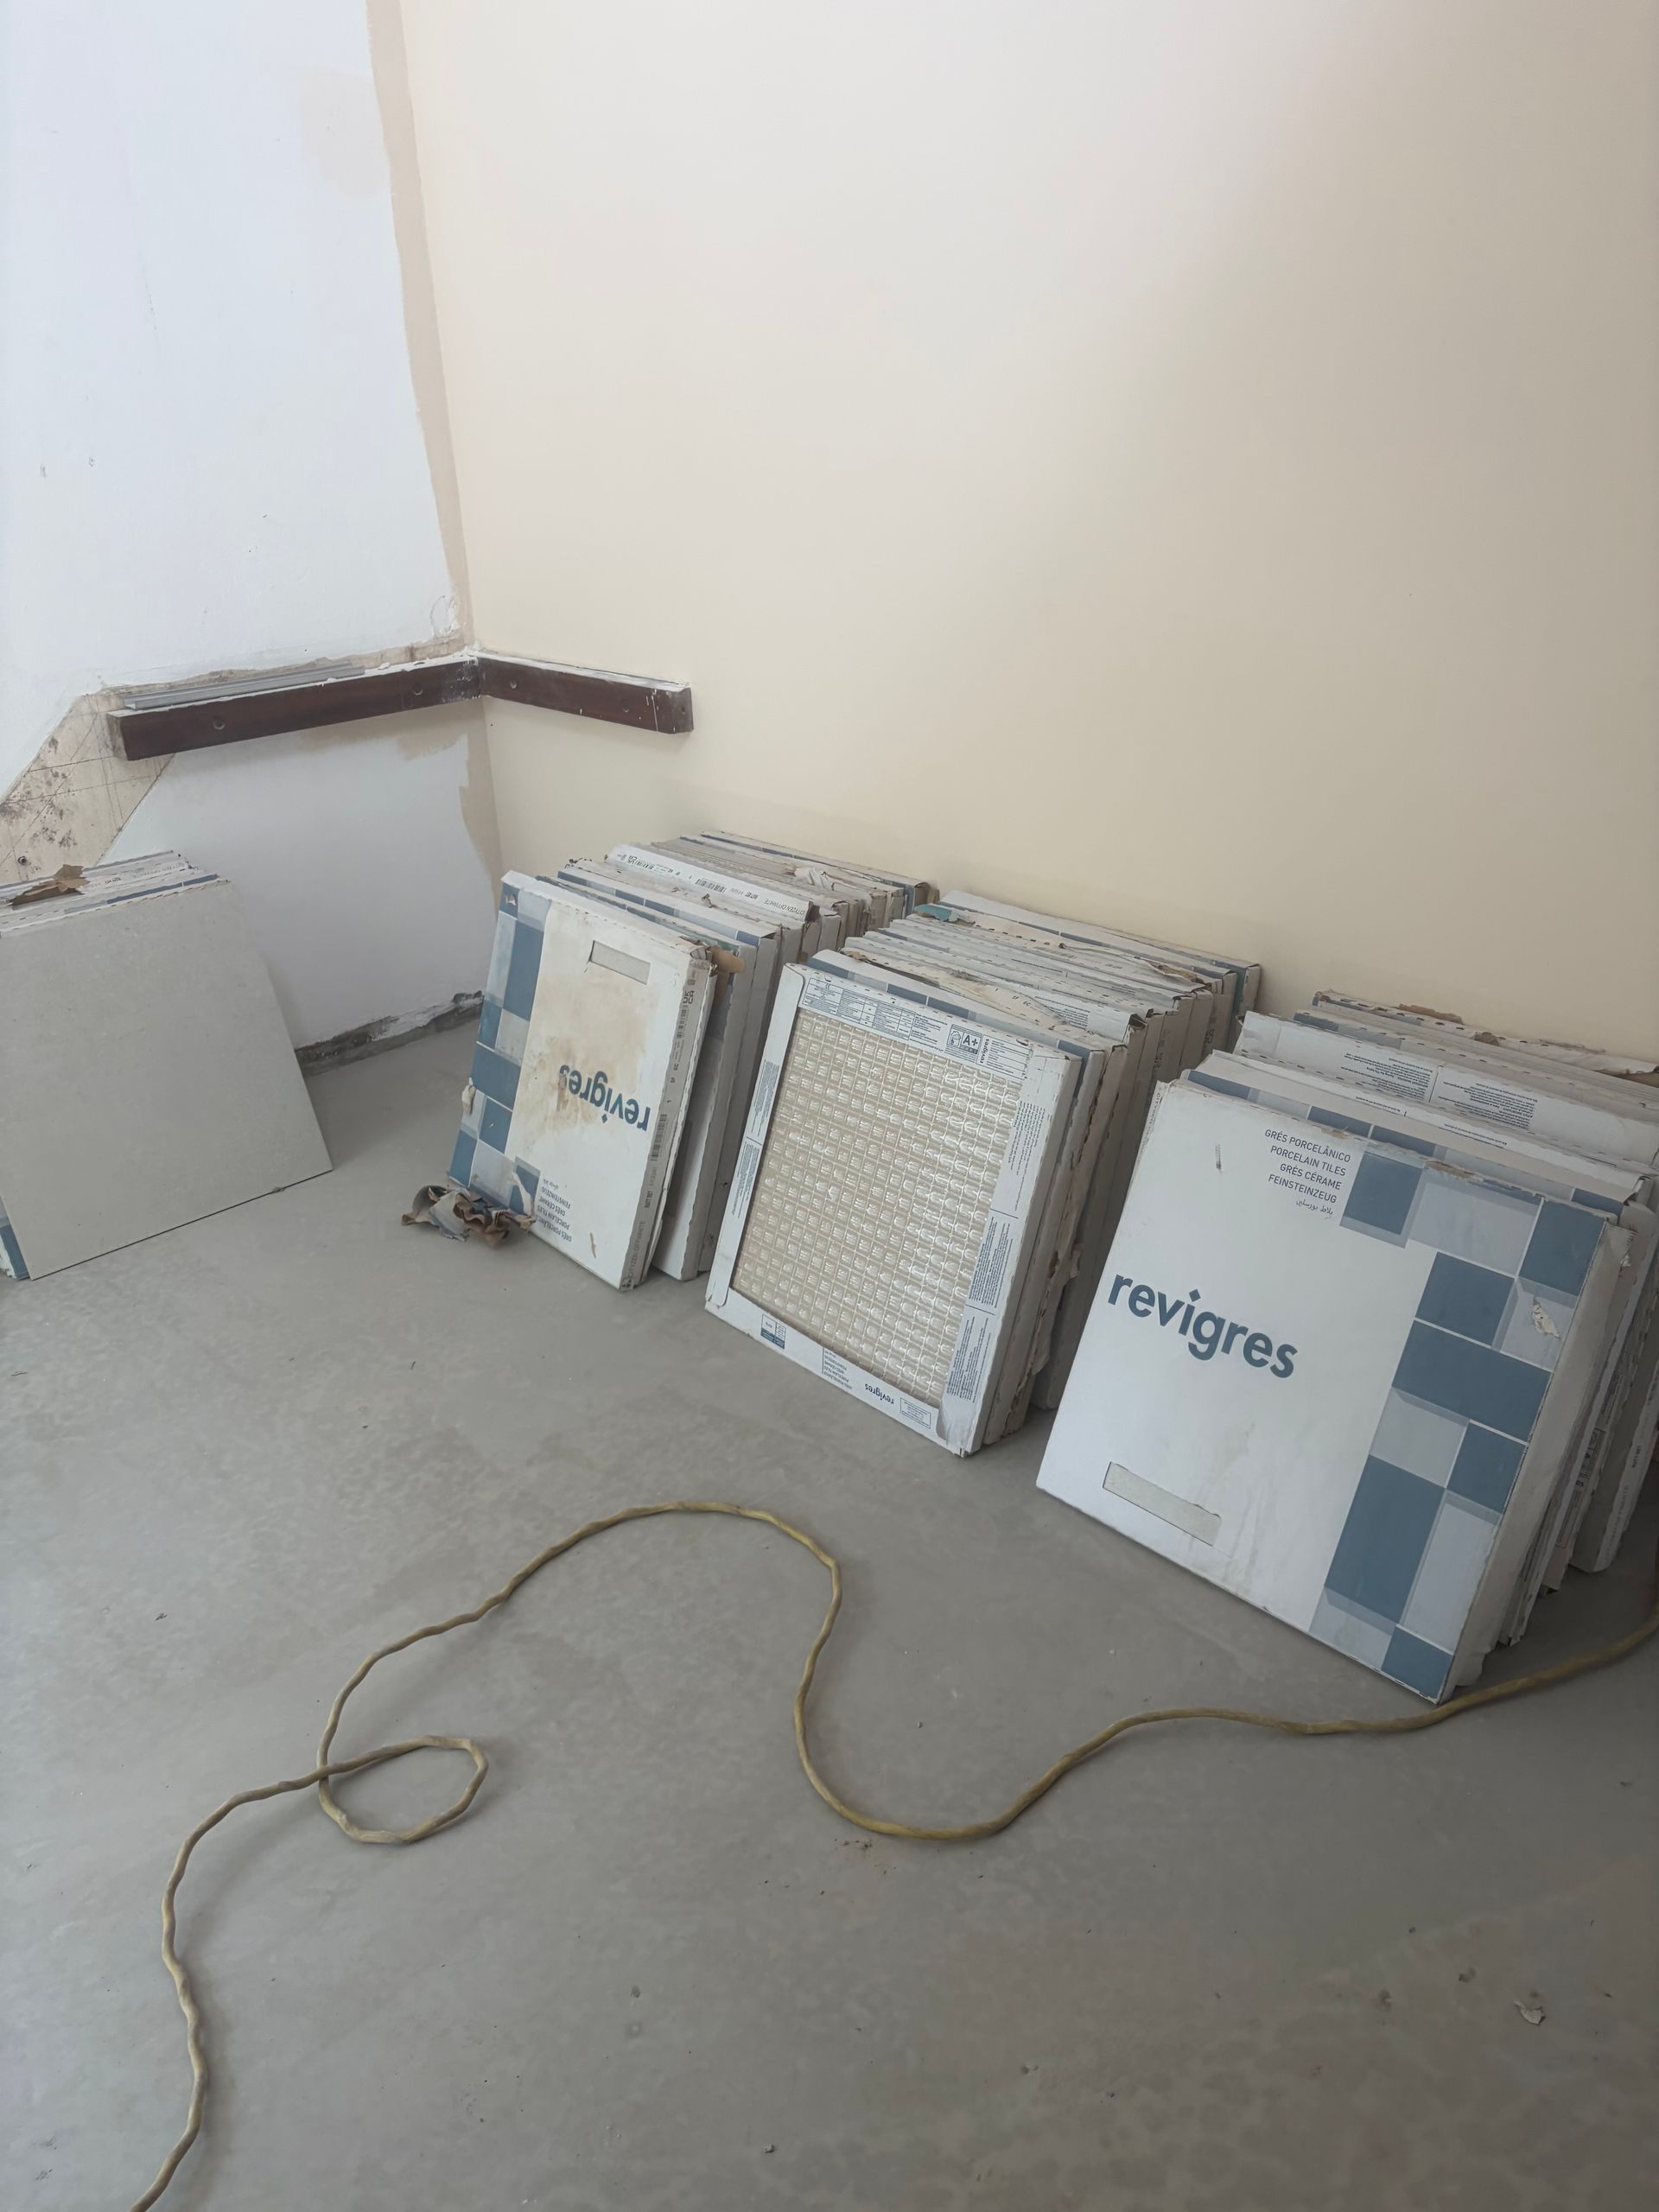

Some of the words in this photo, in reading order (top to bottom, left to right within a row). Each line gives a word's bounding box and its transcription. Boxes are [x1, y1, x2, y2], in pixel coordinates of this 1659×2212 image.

[963, 1034, 979, 1046] A+
[980, 1038, 990, 1065] revigres
[1264, 1128, 1288, 1143] GRÉS
[1288, 1136, 1351, 1163] PORCELÂNICO
[1270, 1145, 1320, 1168] PORCELAIN
[1322, 1161, 1347, 1177] TILES
[1268, 1173, 1338, 1204] FEINSTEINZEUG
[1305, 1172, 1342, 1191] CÉRAME
[1107, 1274, 1299, 1379] revigres
[864, 1382, 895, 1406] revigres
